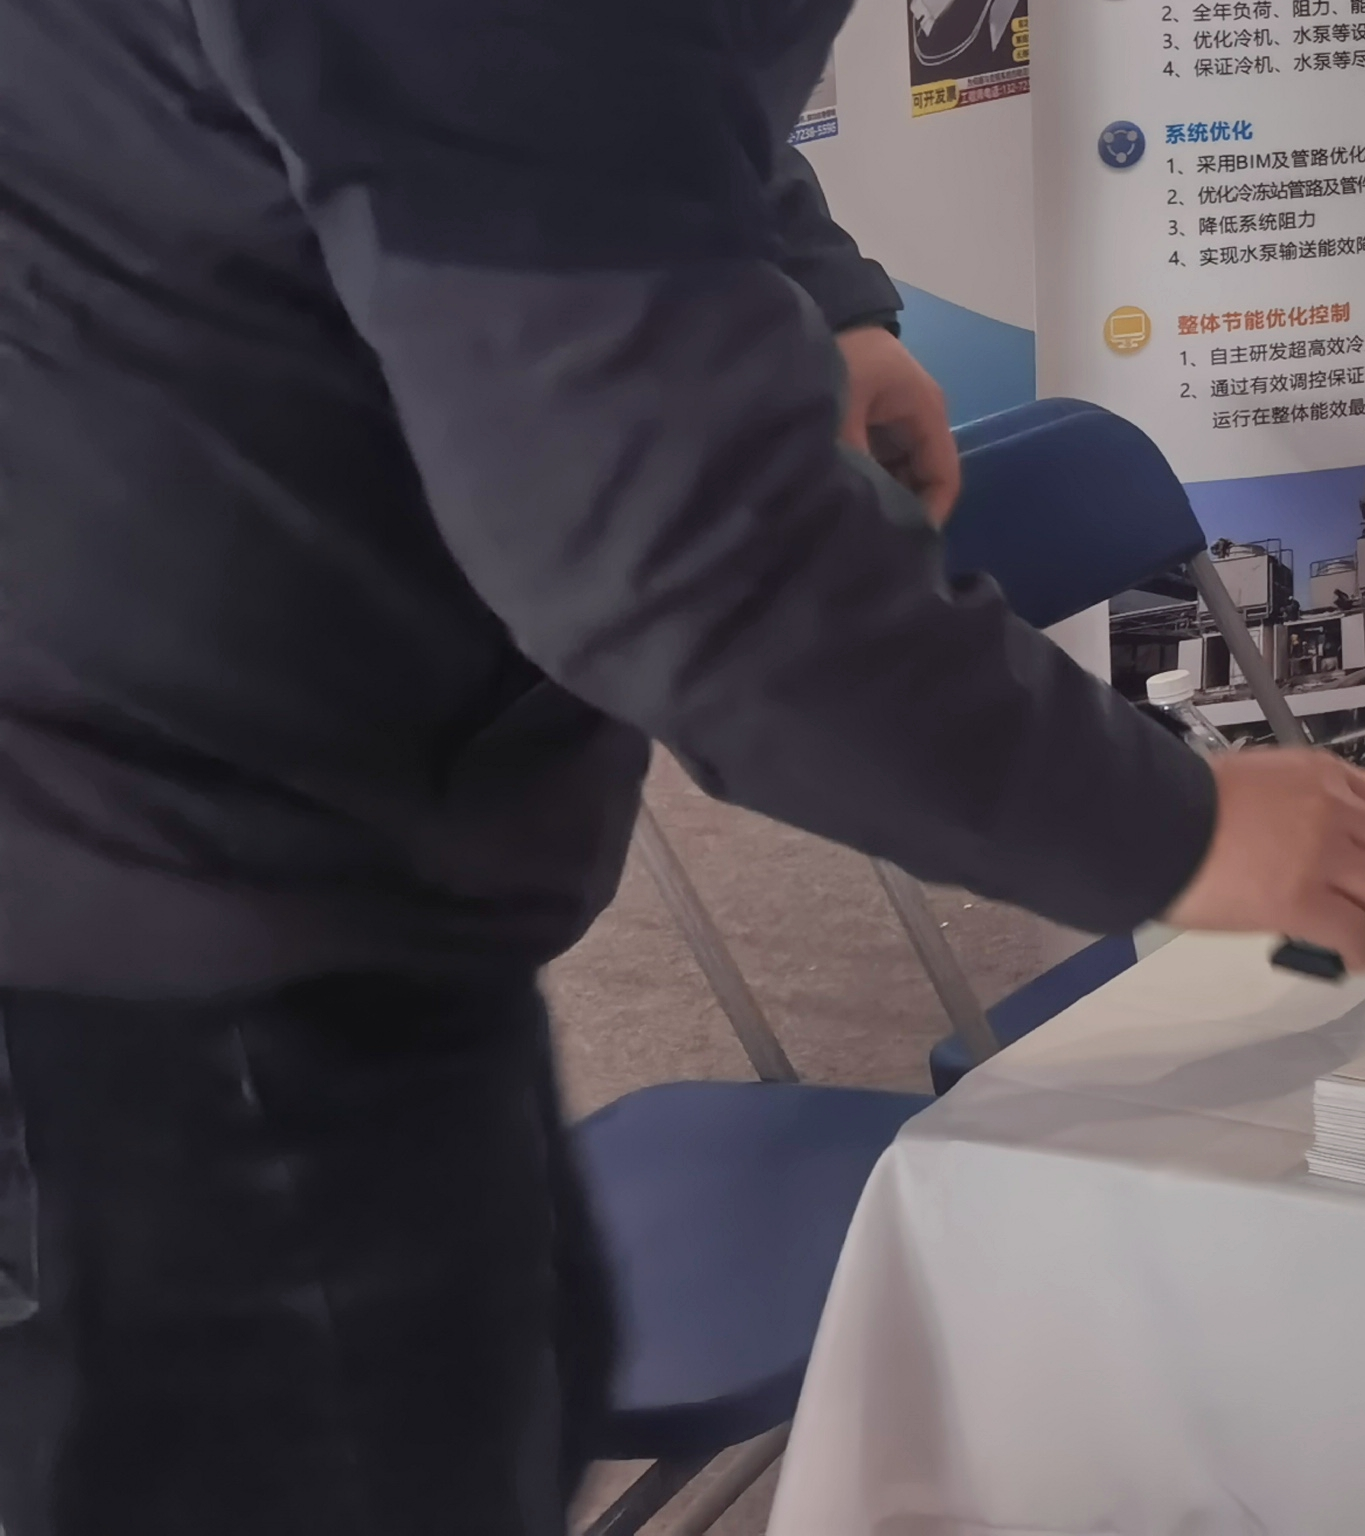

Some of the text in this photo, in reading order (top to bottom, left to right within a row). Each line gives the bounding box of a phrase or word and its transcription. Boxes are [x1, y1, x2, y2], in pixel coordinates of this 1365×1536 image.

[913, 85, 957, 110] 可开发票
[1165, 121, 1253, 146] 系统优化
[1167, 209, 1317, 238] 3、降低系统阻力
[1177, 302, 1351, 336] 整体节能优化控制
